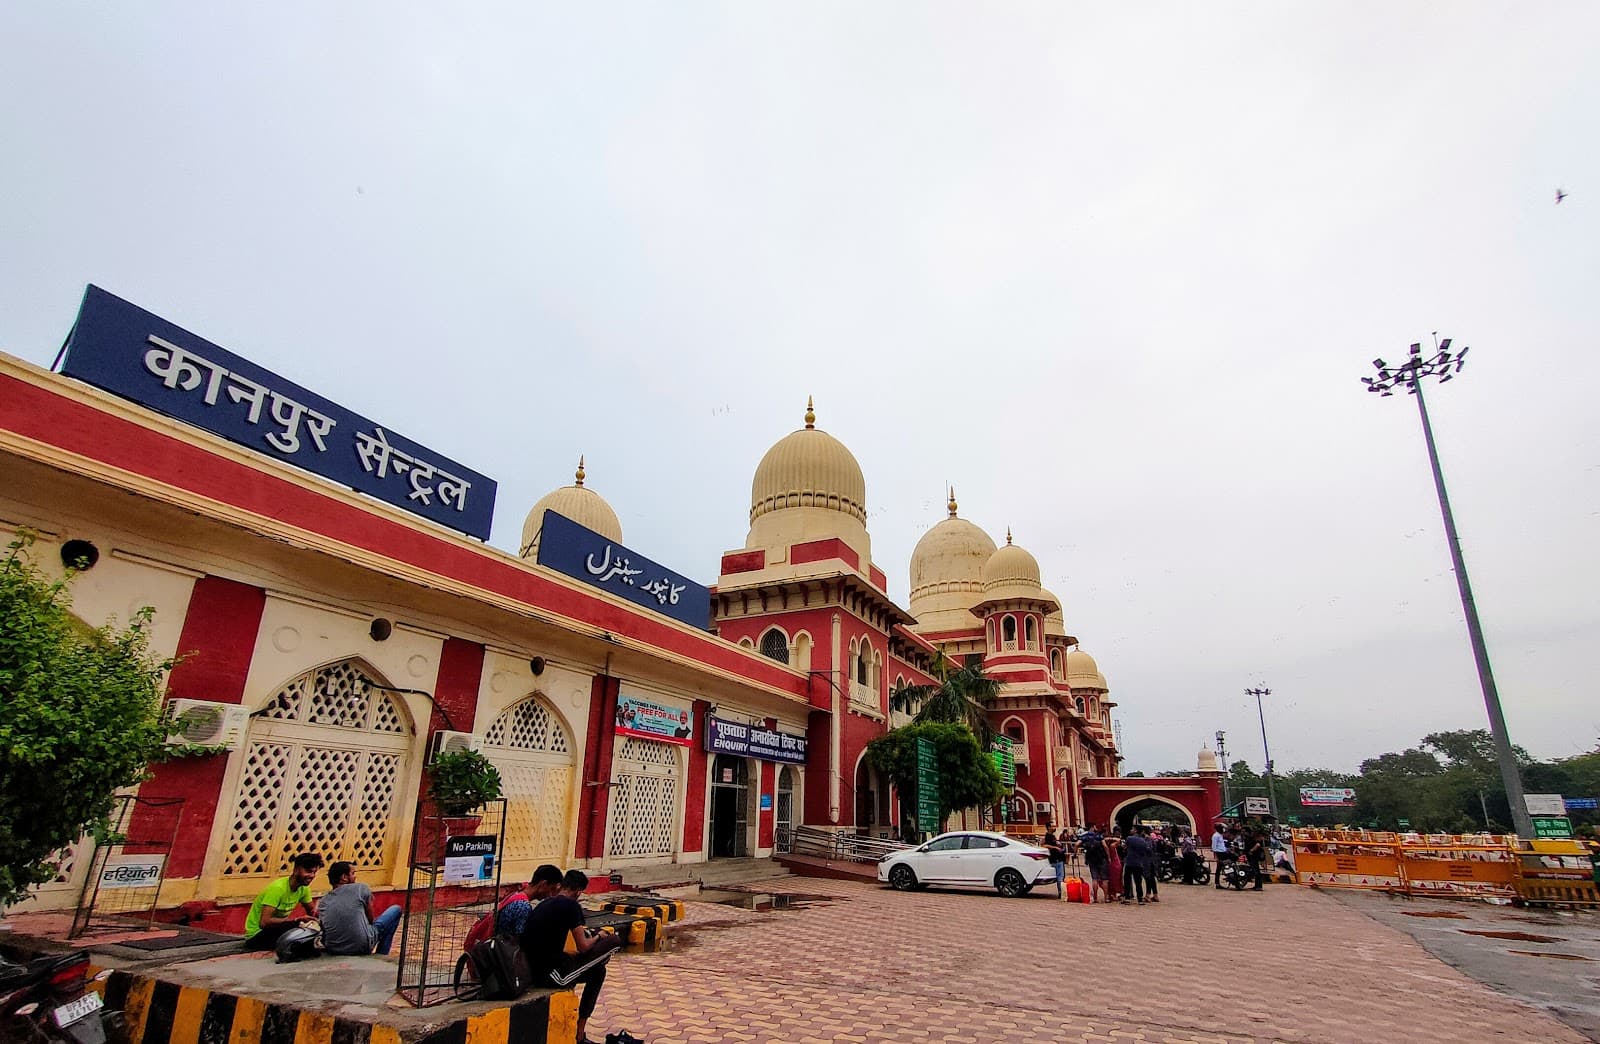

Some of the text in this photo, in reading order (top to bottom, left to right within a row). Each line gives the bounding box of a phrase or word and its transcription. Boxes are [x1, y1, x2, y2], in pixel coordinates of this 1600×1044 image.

[145, 334, 472, 511] कानपुर सेन्ट्रल
[587, 544, 686, 605] کانپور سینٹرل
[637, 706, 653, 716] FREE
[654, 709, 667, 718] FOR
[667, 713, 679, 722] ALL
[716, 721, 747, 739] पूछताछ
[714, 738, 748, 752] ENQUIRY
[452, 841, 493, 852] No Parking
[103, 865, 159, 881] हरियाली
